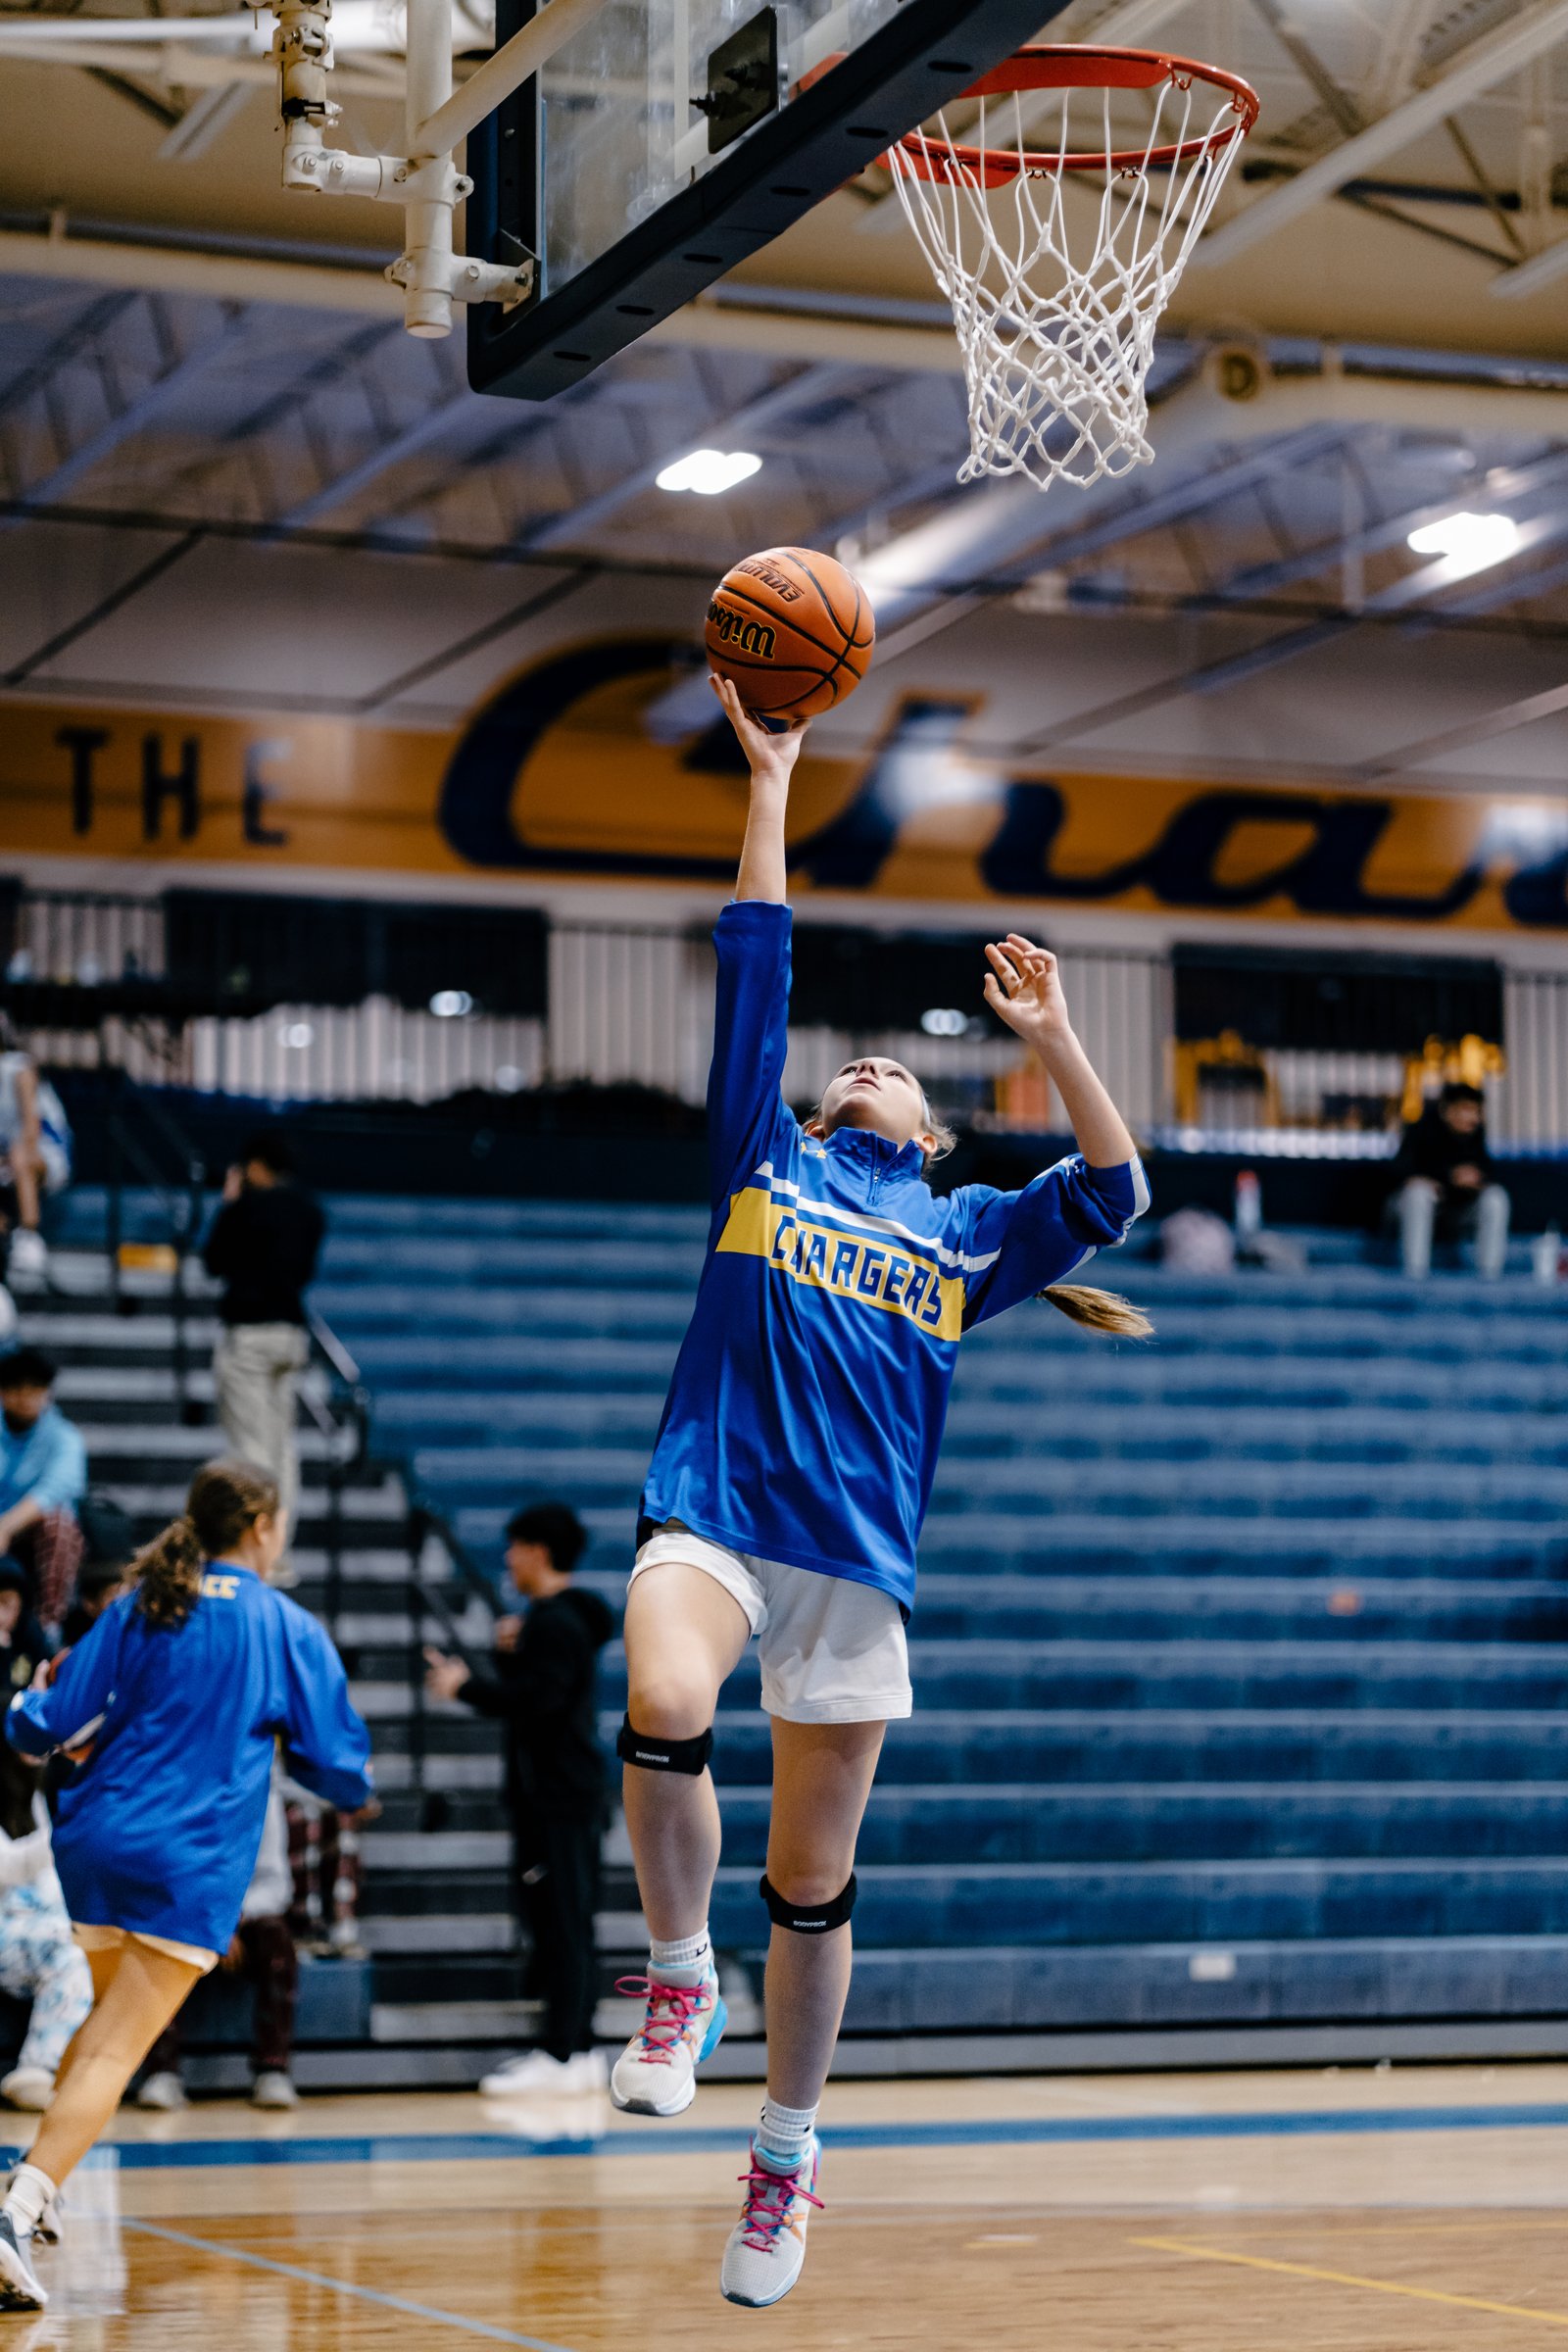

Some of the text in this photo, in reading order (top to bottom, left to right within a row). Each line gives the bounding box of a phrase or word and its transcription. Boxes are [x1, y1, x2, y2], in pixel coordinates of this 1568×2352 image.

[707, 602, 777, 660] Wilso
[55, 726, 291, 846] THE
[771, 1214, 943, 1327] CHARGERS
